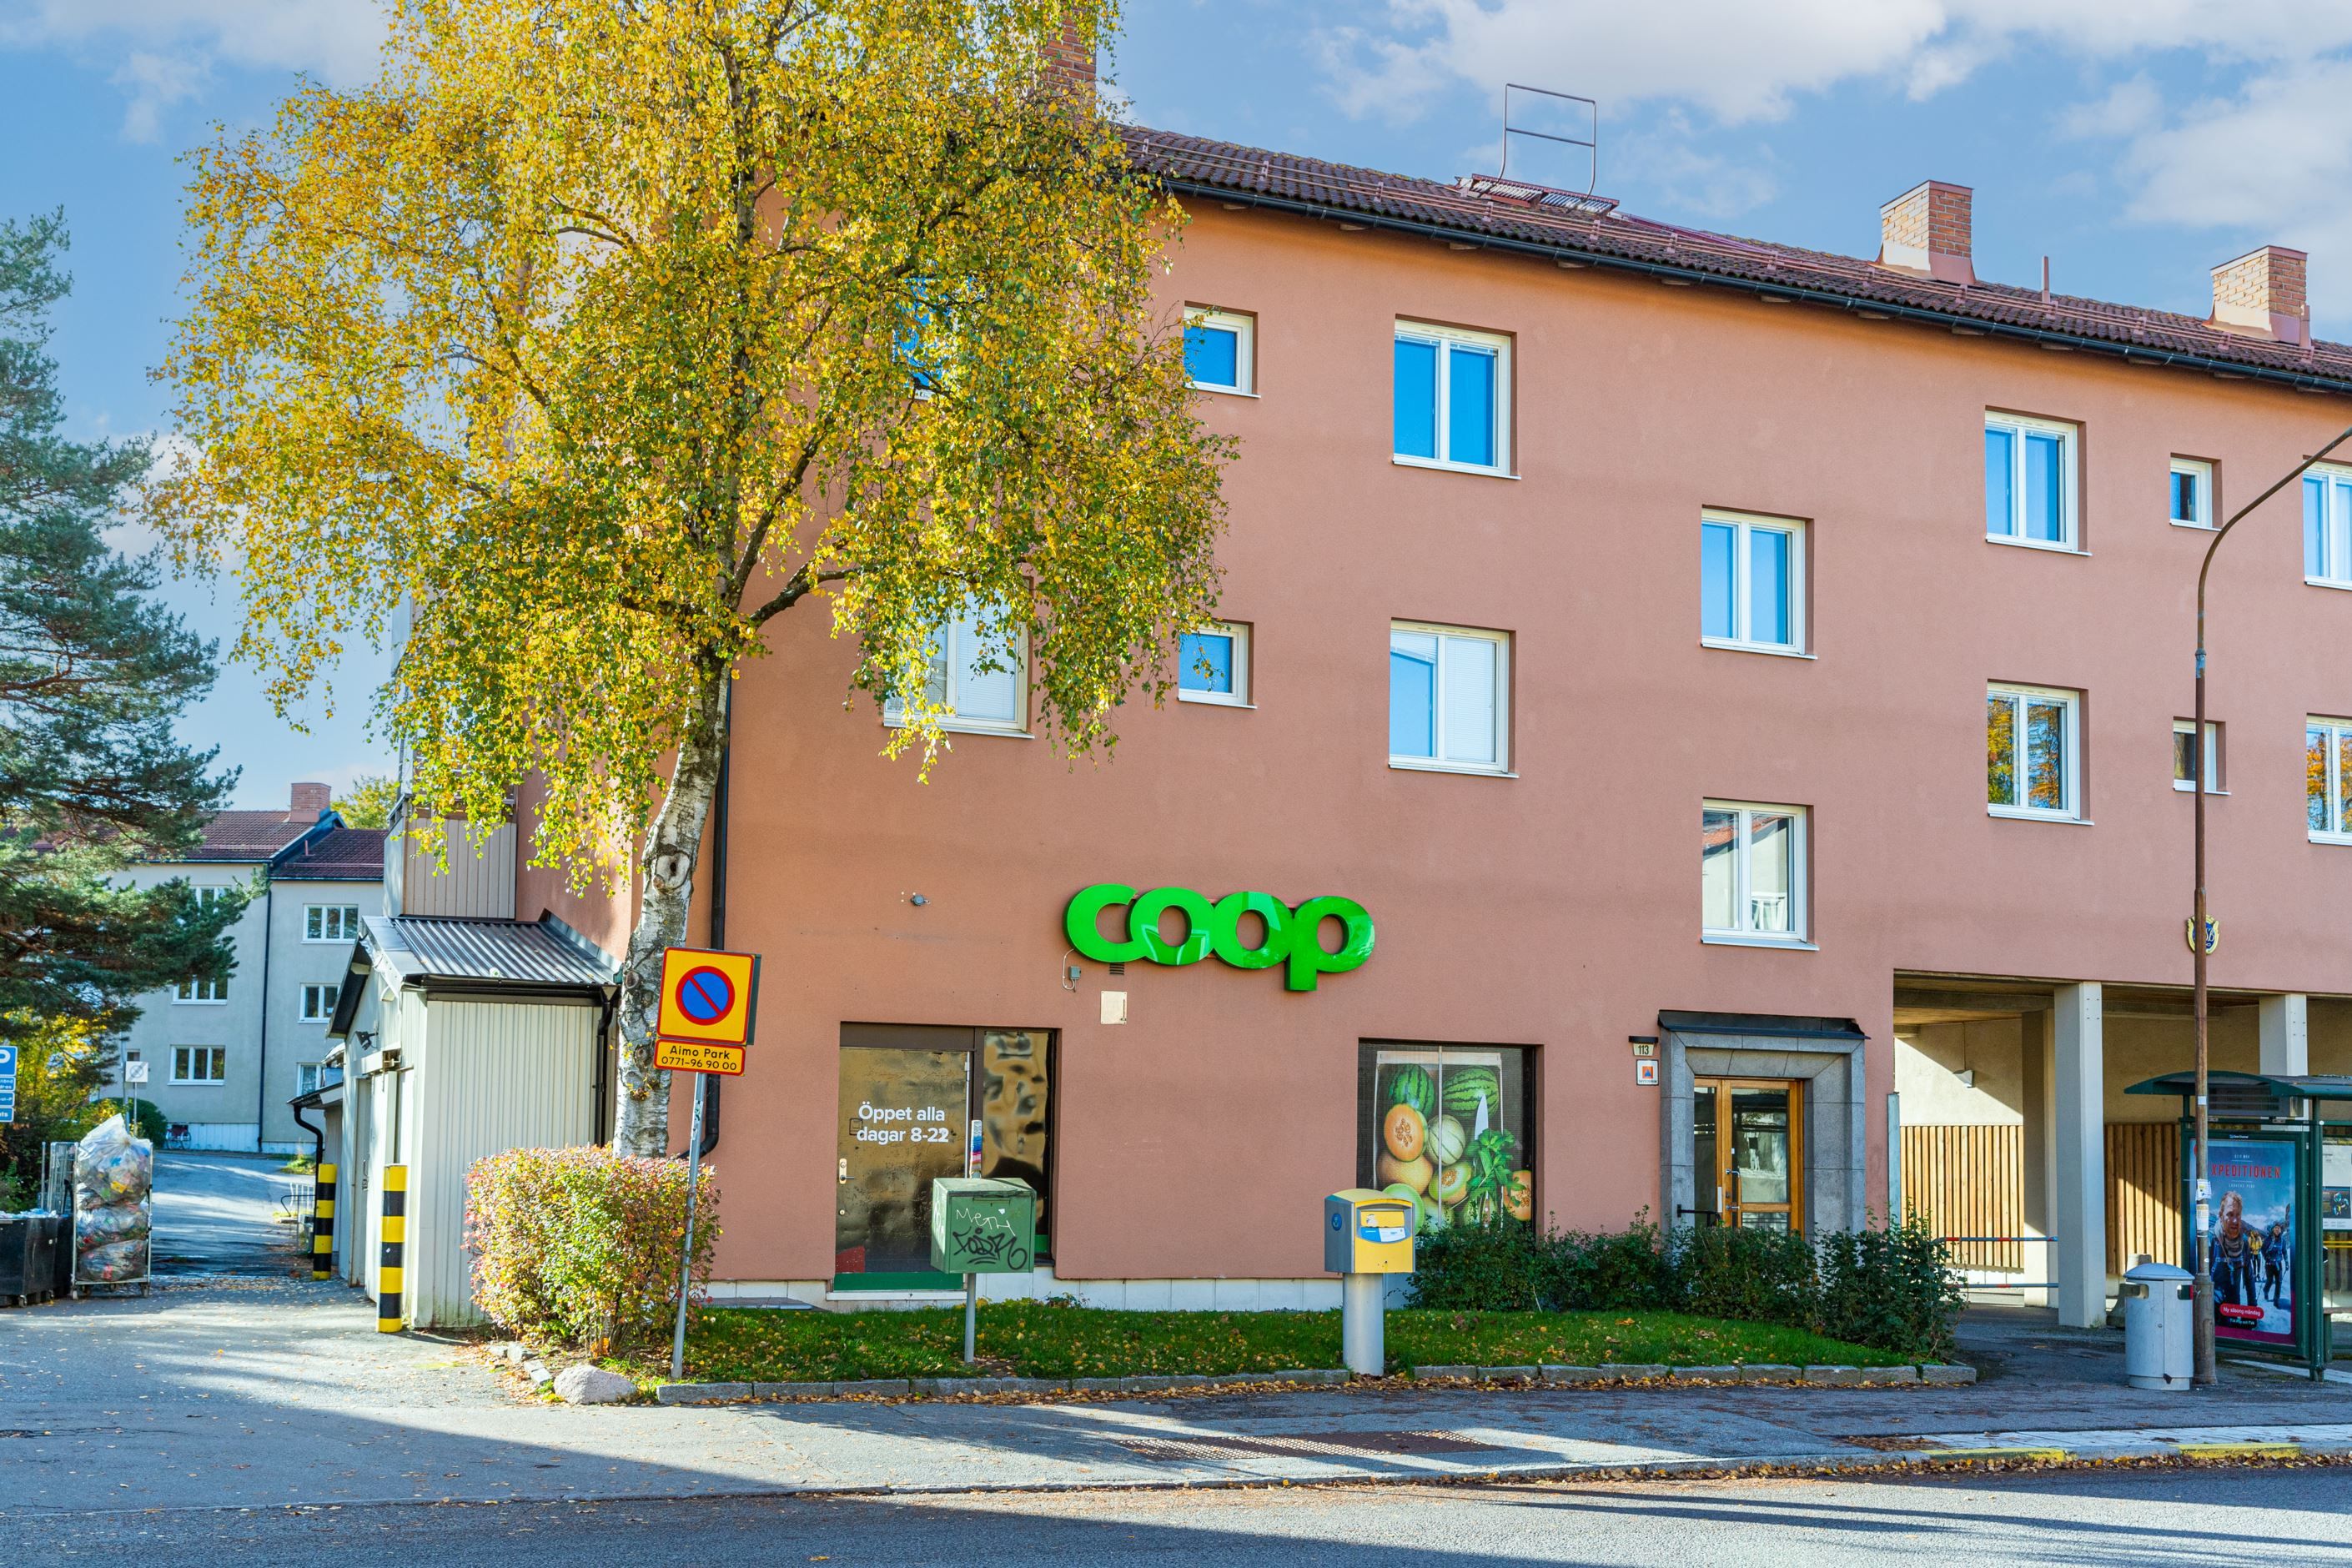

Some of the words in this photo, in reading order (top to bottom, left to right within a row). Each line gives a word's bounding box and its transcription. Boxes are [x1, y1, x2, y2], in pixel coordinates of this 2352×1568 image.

[1063, 882, 1375, 992] coop
[670, 1045, 699, 1057] Aimo
[704, 1048, 731, 1060] Park
[1638, 1044, 1650, 1055] 113
[661, 1056, 702, 1068] 0771-96
[706, 1060, 719, 1069] 90
[722, 1062, 737, 1071] 00
[858, 1101, 912, 1123] Öppet
[917, 1106, 945, 1121] alla
[857, 1126, 907, 1145] dagar
[910, 1127, 949, 1143] 8-22
[2211, 1164, 2281, 1179] XPEDITIONEN
